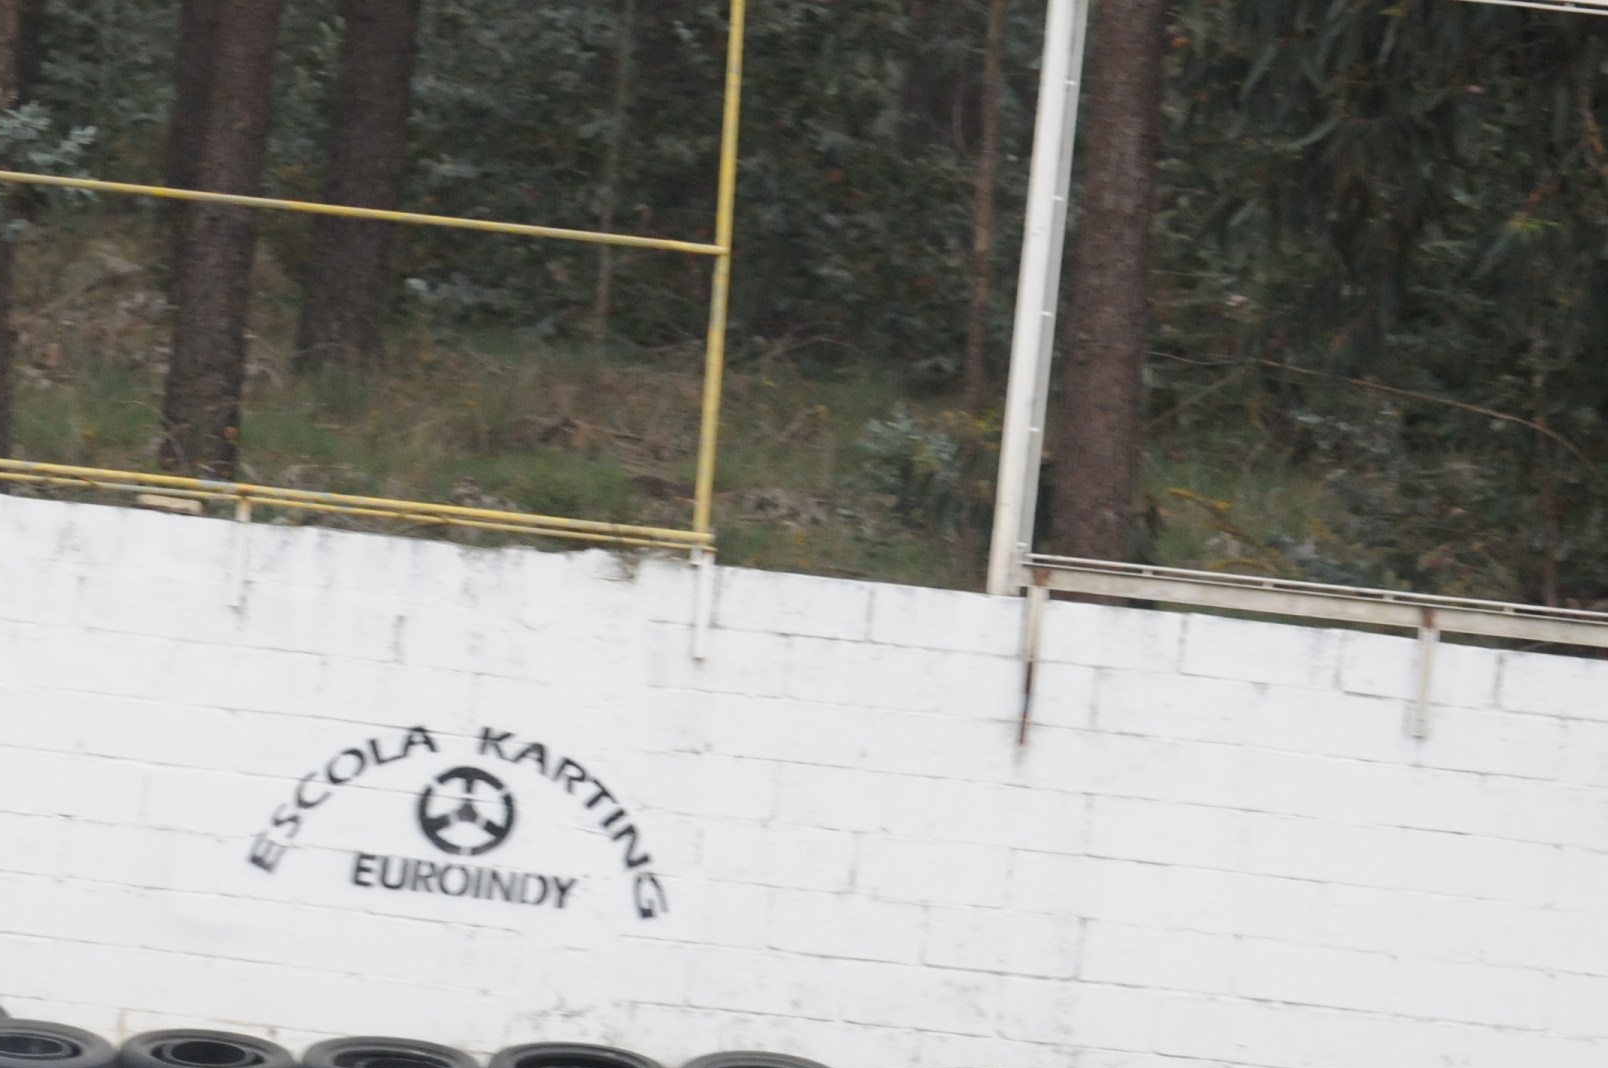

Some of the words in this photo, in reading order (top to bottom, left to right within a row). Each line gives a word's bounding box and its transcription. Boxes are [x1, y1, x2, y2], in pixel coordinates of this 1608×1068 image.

[246, 725, 438, 873] ESCOLA
[477, 726, 668, 919] KARTING
[350, 851, 579, 910] EUROINDY
